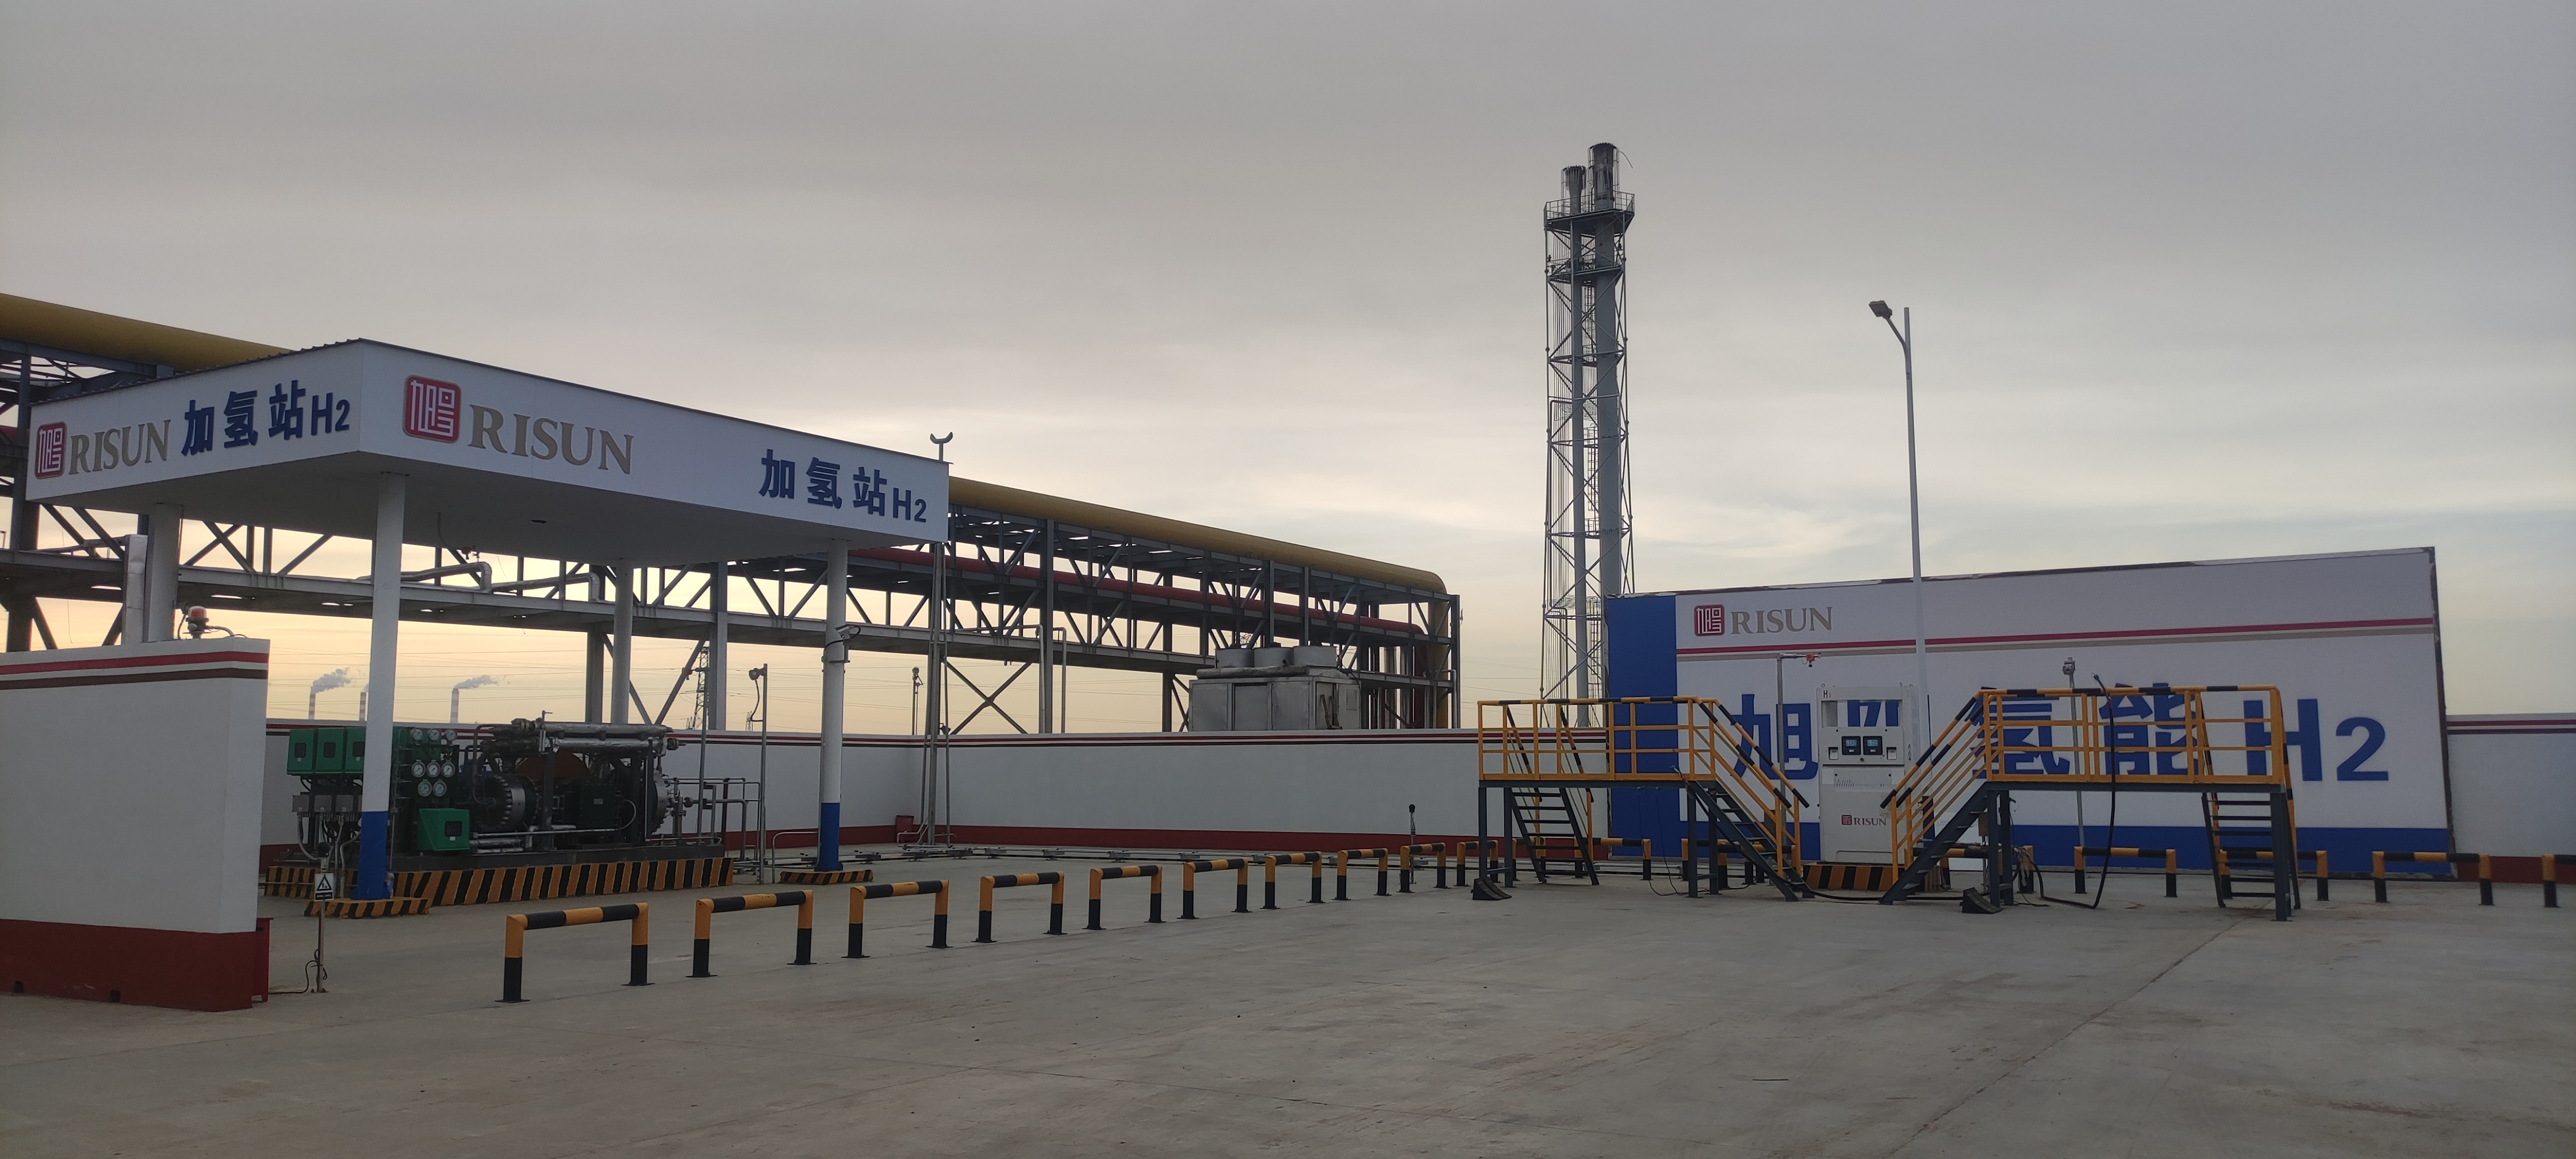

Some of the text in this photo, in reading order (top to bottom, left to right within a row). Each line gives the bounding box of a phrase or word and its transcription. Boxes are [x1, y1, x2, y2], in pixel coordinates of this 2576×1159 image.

[68, 419, 171, 475] RISUN
[468, 404, 635, 474] RISUN
[1730, 607, 1833, 635] RISUN
[1853, 817, 1887, 826] RISUN
